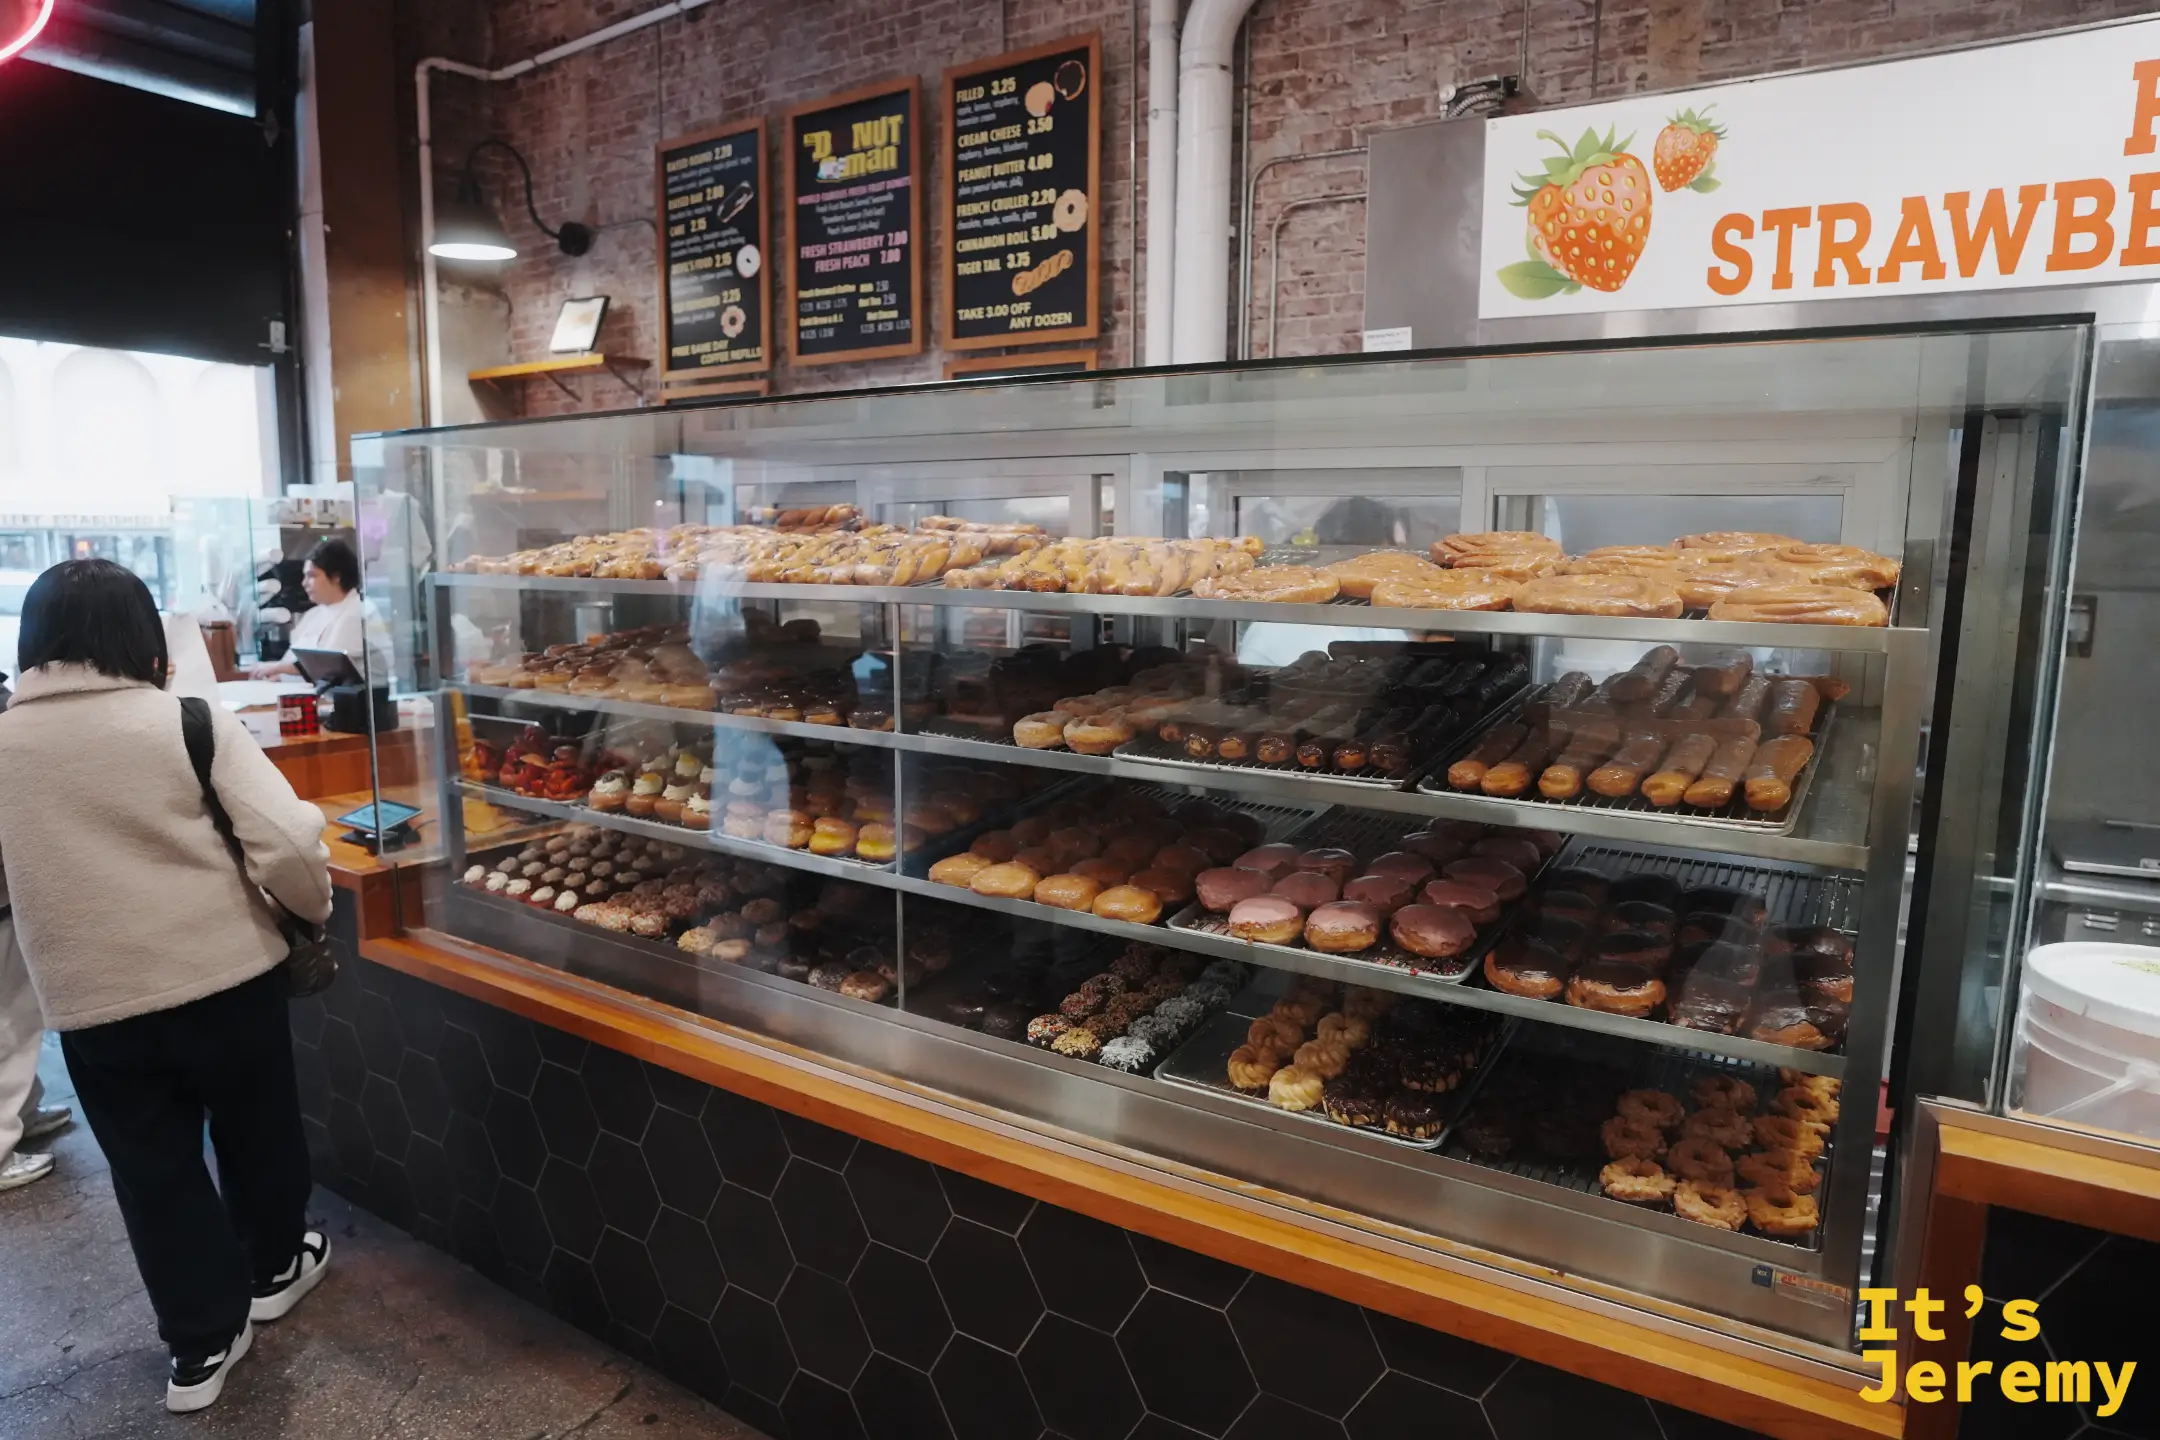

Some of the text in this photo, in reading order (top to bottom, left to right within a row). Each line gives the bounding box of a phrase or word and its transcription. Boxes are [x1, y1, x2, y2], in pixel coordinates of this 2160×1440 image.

[956, 76, 1016, 103] FILLED 3.25
[958, 115, 1054, 148] CREAM CHEESE 3.50
[958, 165, 993, 183] PEANUT
[993, 159, 1026, 177] BUTTER
[956, 188, 1057, 217] FRENCH CRULLER 2.20
[801, 244, 827, 259] FRESH
[827, 234, 885, 256] STRAWBERRY
[956, 233, 1005, 253] CINNAMON
[1006, 230, 1030, 245] ROLL
[815, 258, 841, 273] FRESH
[842, 253, 870, 270] PEACH
[957, 251, 1031, 276] TIGER TAIL 3.75
[957, 302, 1032, 321] TAKE 3.00 OFF
[1009, 312, 1073, 330] ANY DOZEN
